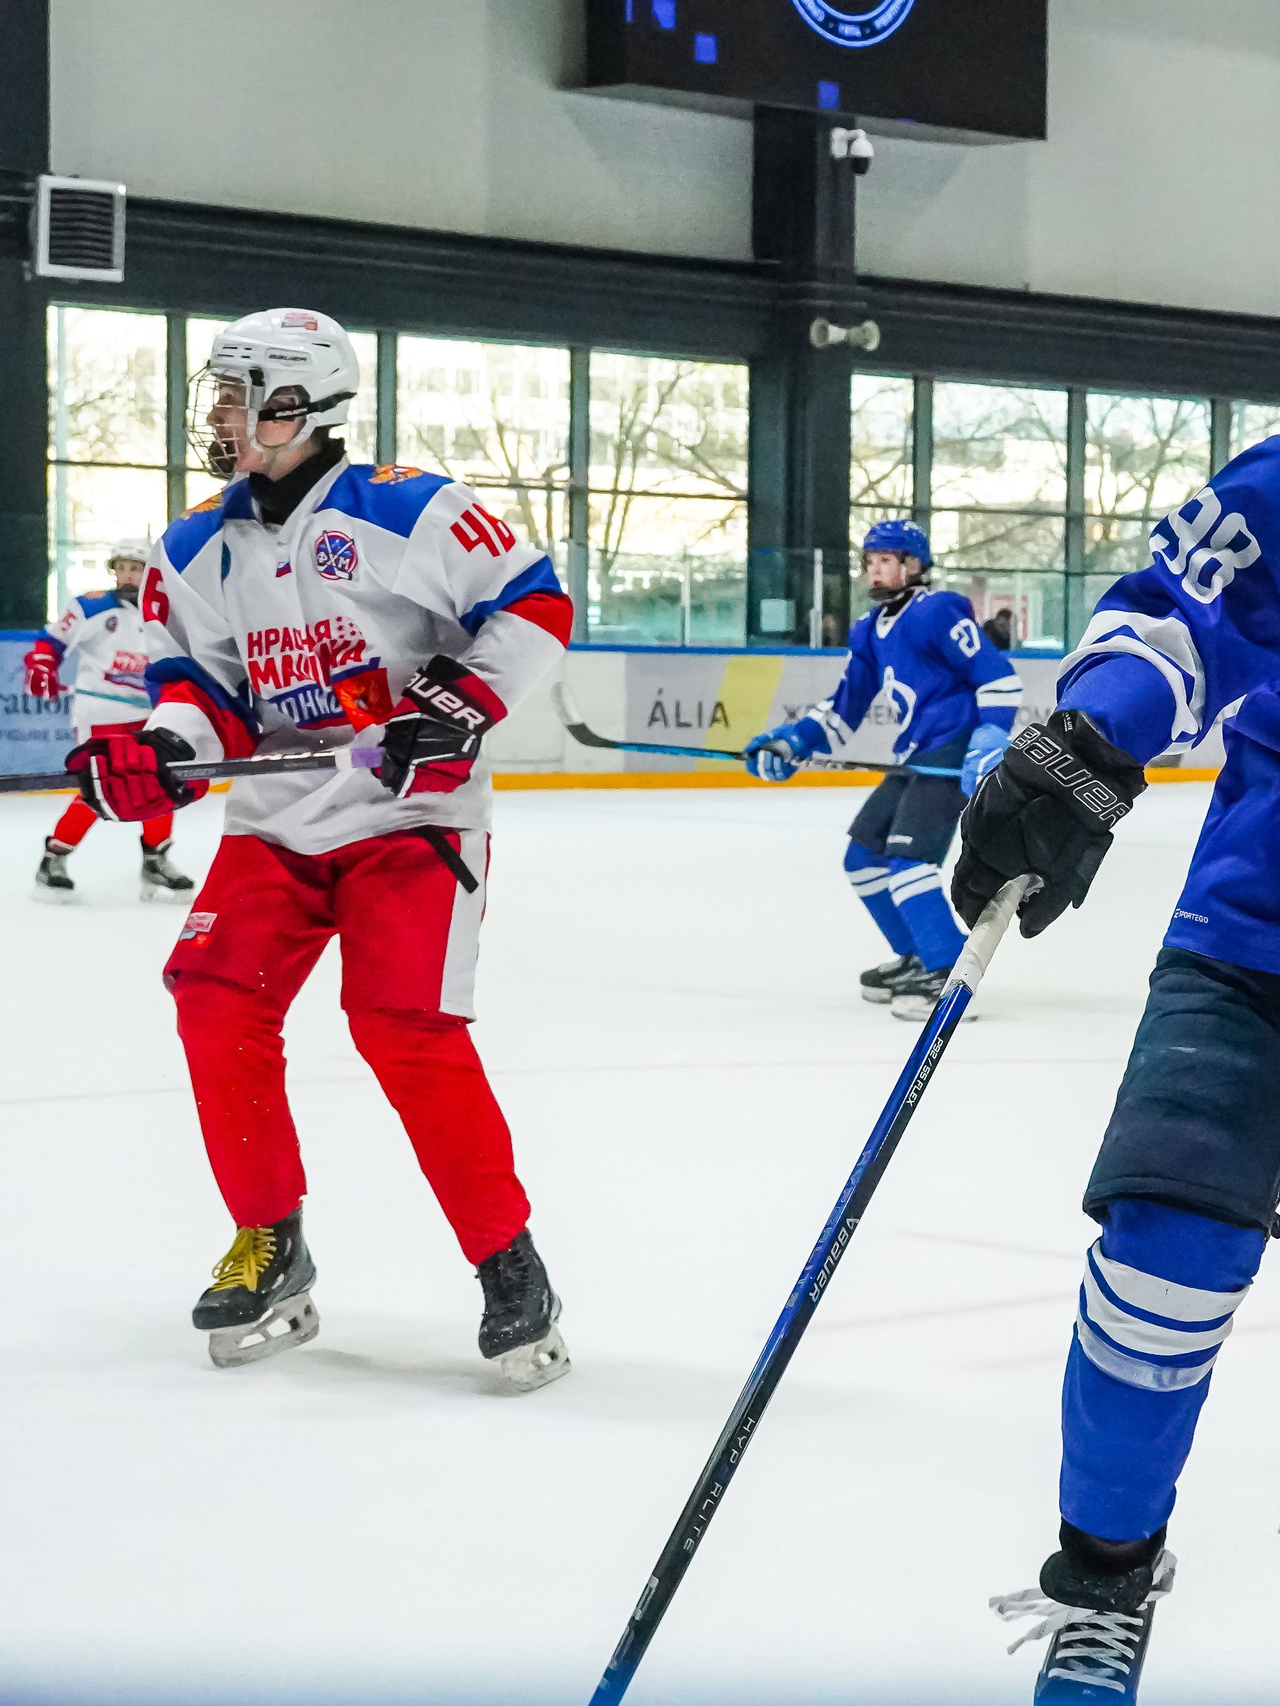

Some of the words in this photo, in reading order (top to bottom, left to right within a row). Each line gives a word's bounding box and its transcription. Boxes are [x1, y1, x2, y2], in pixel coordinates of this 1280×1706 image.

[1149, 486, 1262, 605] 98
[929, 1037, 944, 1060] P92
[906, 1079, 924, 1107] FLEX
